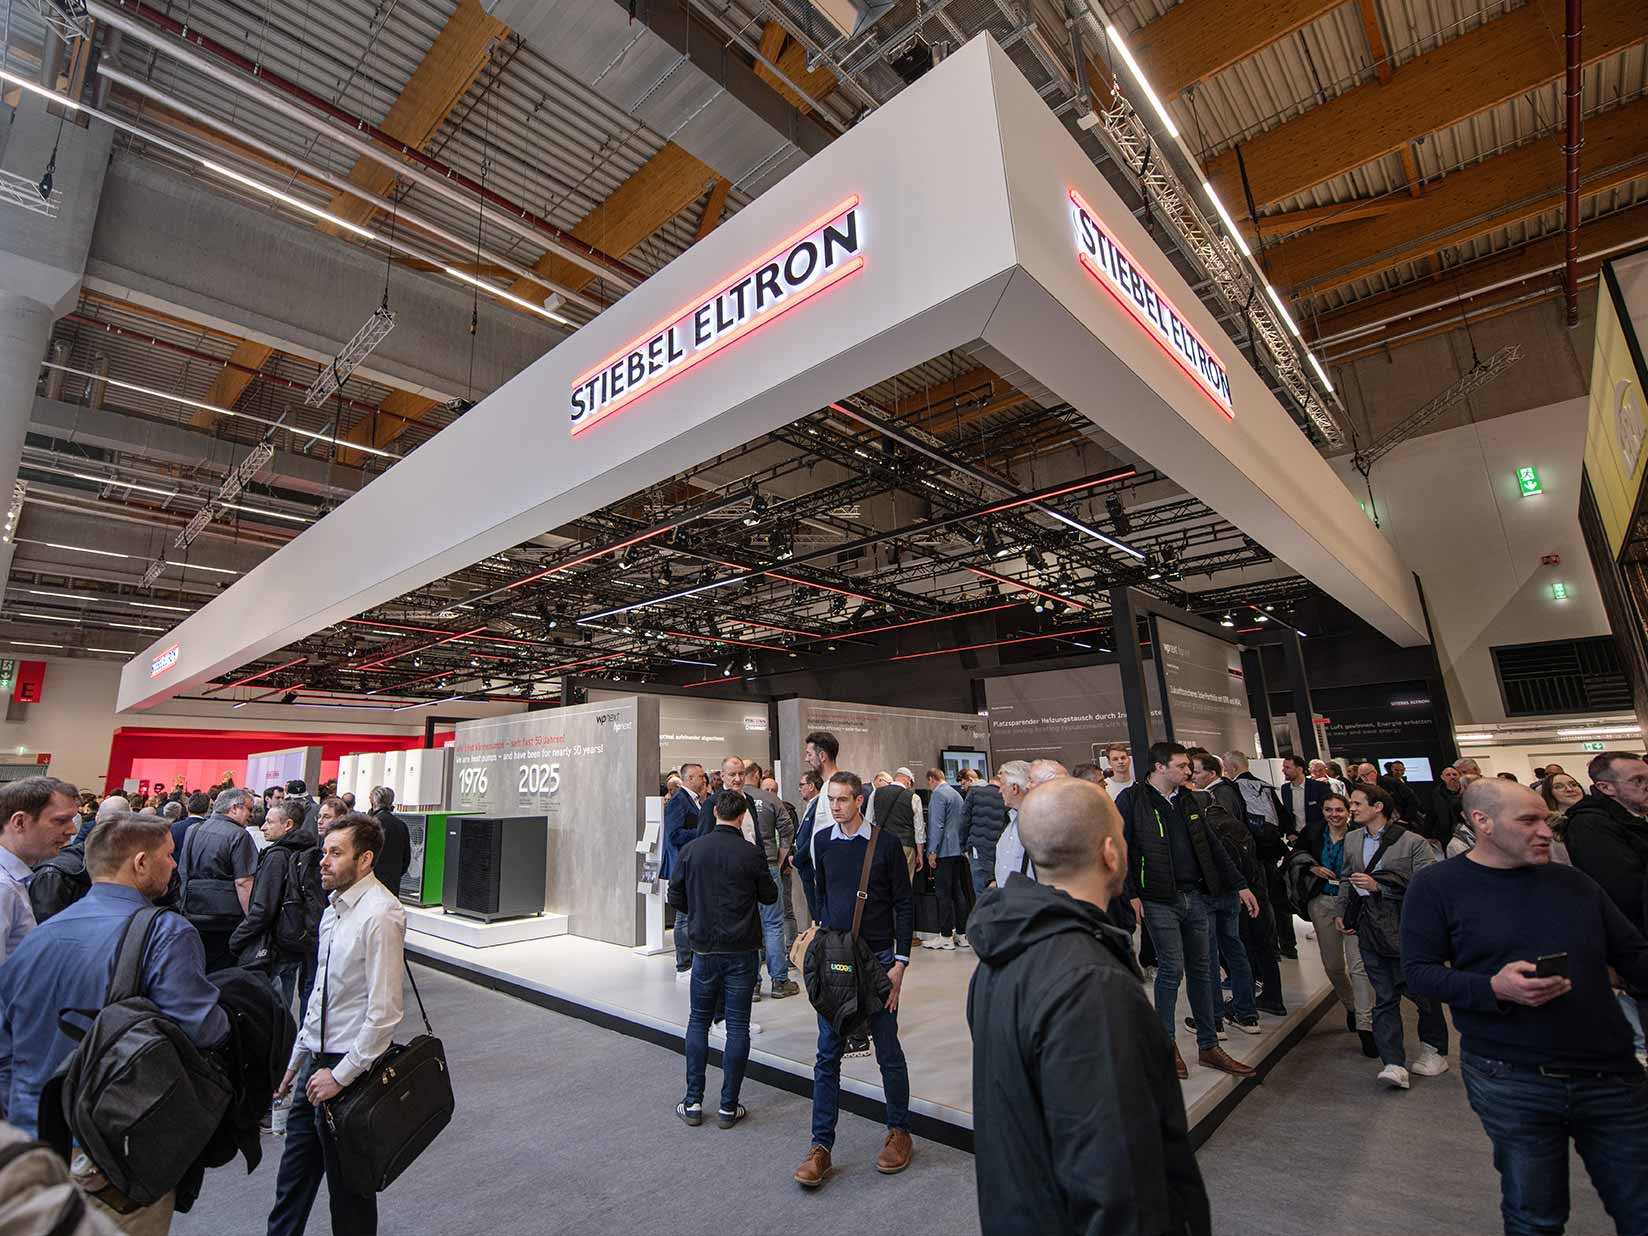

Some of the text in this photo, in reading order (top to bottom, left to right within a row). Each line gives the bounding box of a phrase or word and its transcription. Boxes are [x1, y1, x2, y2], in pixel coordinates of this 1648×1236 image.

[570, 210, 859, 421] STIEBEL ELTRON
[1078, 208, 1233, 405] STIEBEL ELTRON
[21, 682, 35, 699] E
[993, 719, 1040, 728] Platzsparender
[1041, 714, 1093, 724] Heizungstausch
[1095, 712, 1116, 720] durch
[503, 751, 513, 760] and
[514, 750, 526, 759] have
[527, 750, 541, 759] been
[542, 748, 551, 758] for
[552, 746, 572, 758] nearly
[573, 745, 582, 756] 50
[583, 743, 604, 756] years!
[459, 763, 561, 793] 1976 2025
